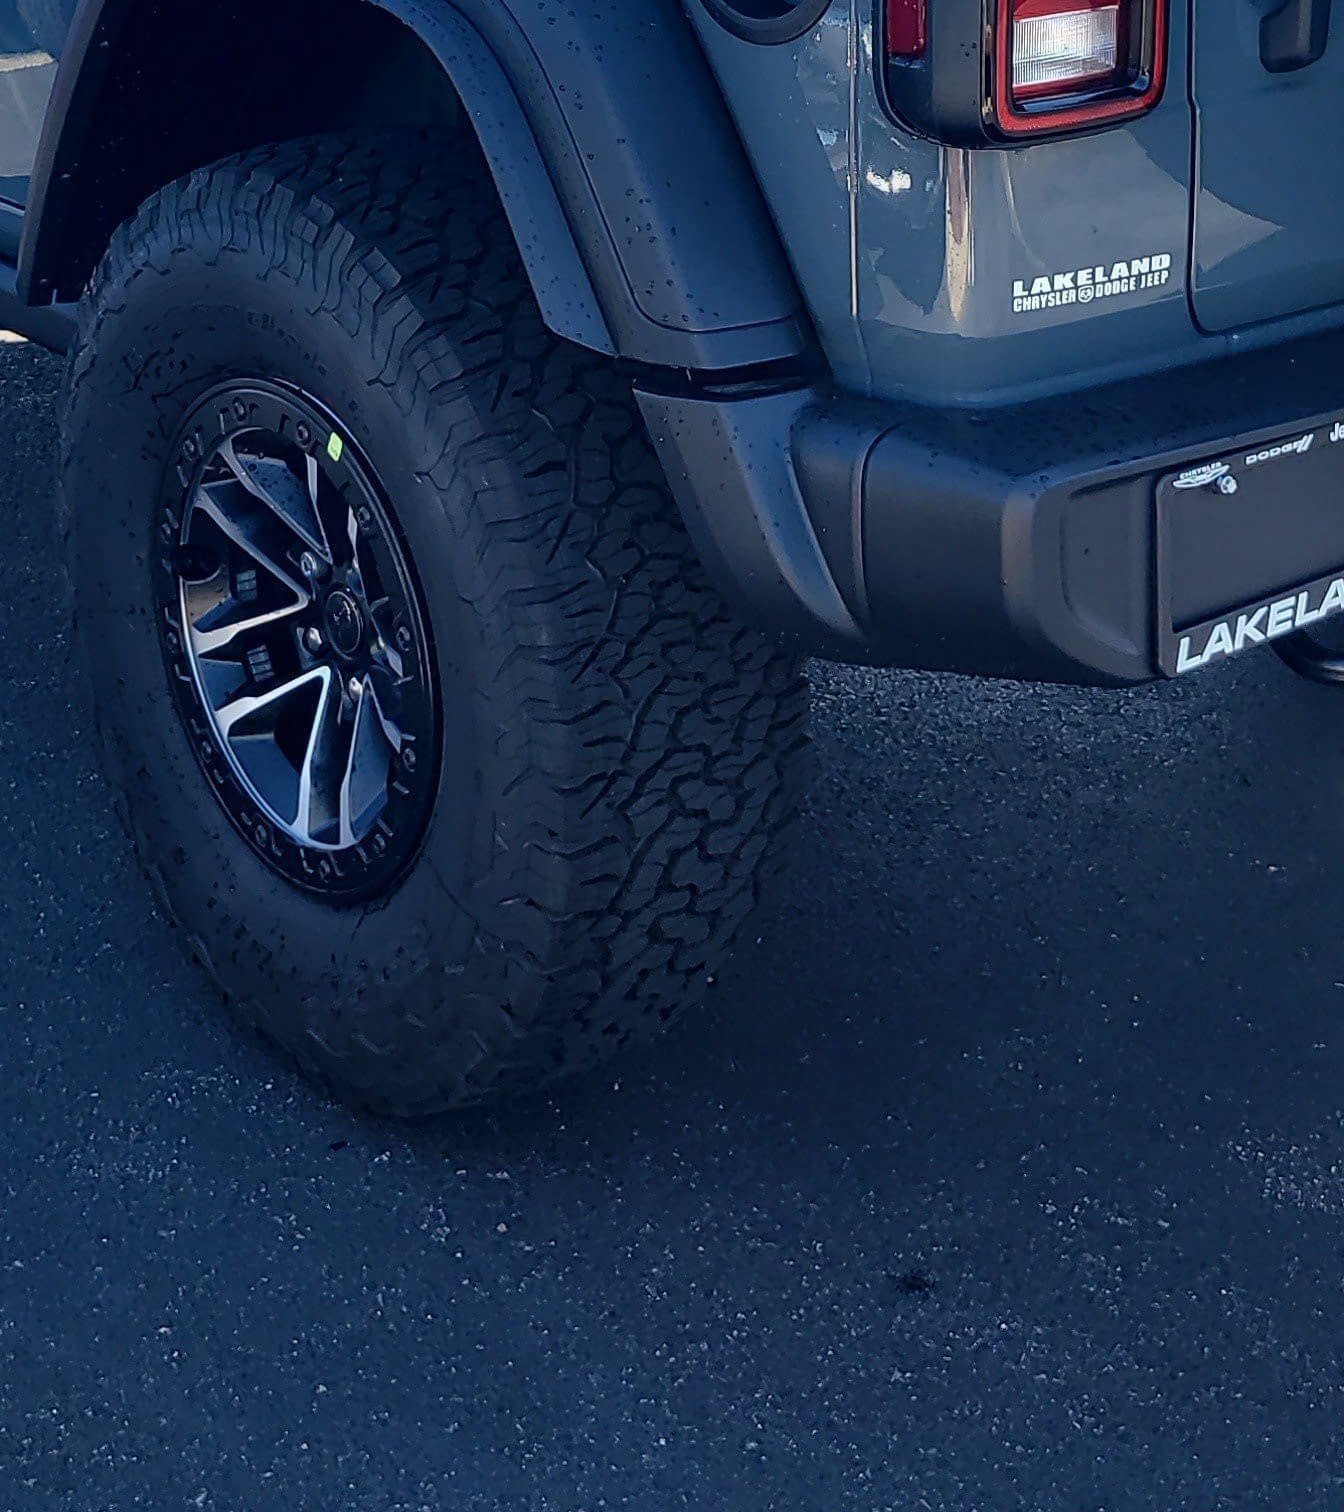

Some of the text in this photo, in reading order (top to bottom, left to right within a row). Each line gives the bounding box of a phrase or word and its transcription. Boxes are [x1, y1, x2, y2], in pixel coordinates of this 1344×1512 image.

[1013, 253, 1171, 297] LAKELAND
[1013, 270, 1169, 312] CHRYSLER DODGE JEEP
